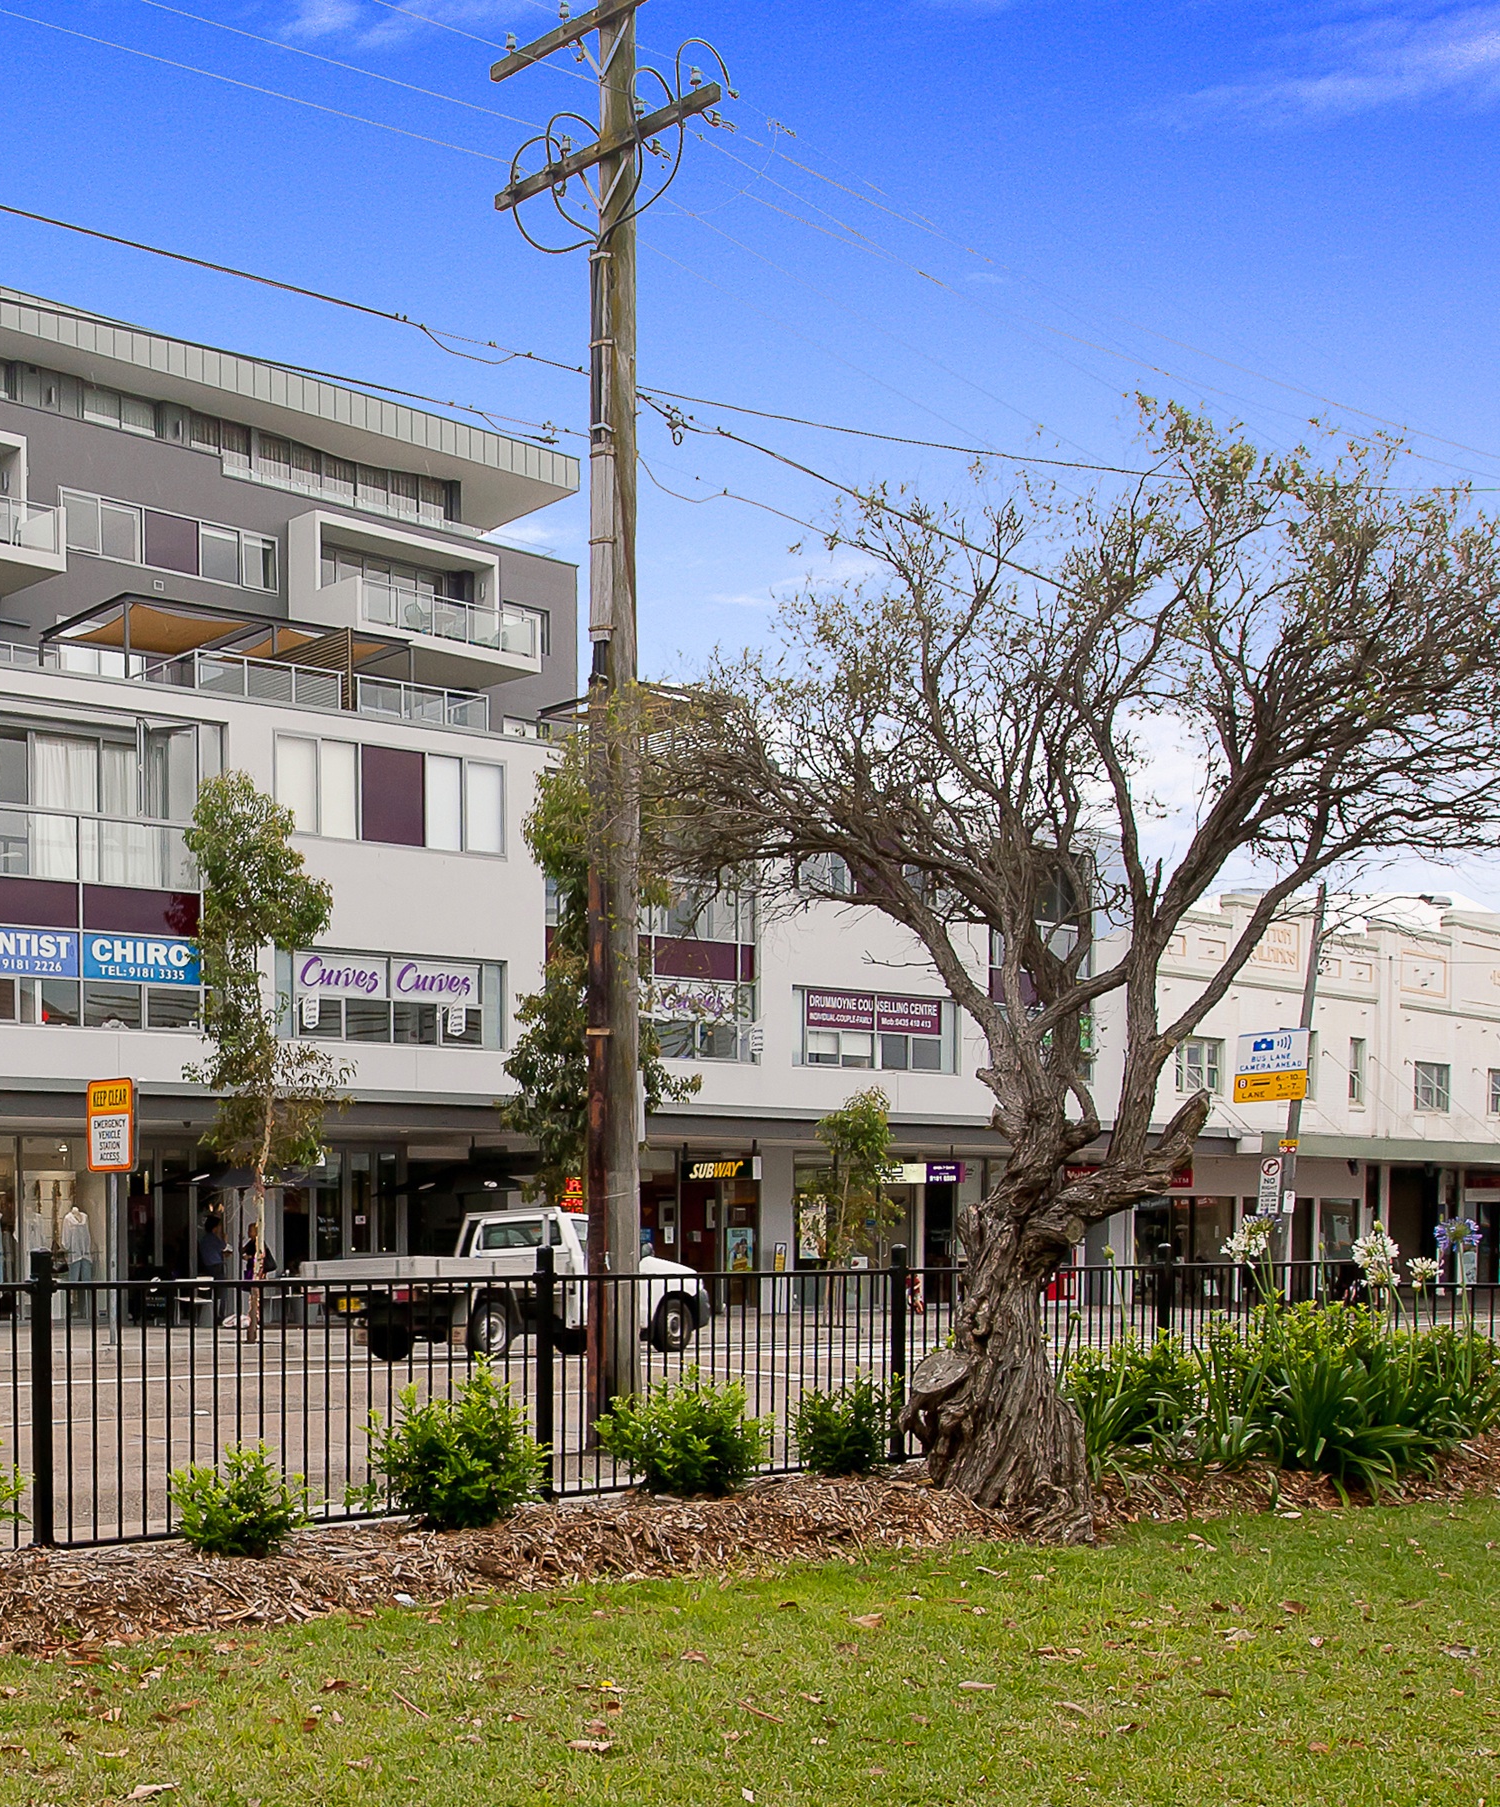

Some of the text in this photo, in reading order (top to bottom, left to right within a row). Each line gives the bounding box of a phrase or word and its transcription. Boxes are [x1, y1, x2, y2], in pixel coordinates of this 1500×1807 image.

[91, 938, 191, 967] CHIRO
[2, 957, 30, 971] 9181
[34, 960, 63, 972] 2226
[99, 964, 185, 981] TEL: 9181 3335
[300, 956, 379, 994] Curves
[396, 962, 471, 996] Curves
[809, 995, 857, 1011] DRUMMOYNE
[909, 1003, 938, 1016] CENTRE
[1270, 1053, 1291, 1061] LANE
[1239, 1060, 1302, 1072] CAMERA AHEAD
[92, 1088, 127, 1107] KEEP CLEAR
[1241, 1091, 1265, 1099] LANE
[93, 1118, 126, 1129] EMERGENCY
[98, 1130, 121, 1140] VEHICLE
[99, 1141, 121, 1151] STATION
[99, 1151, 120, 1161] ACCESS
[689, 1160, 744, 1179] SUBWAY
